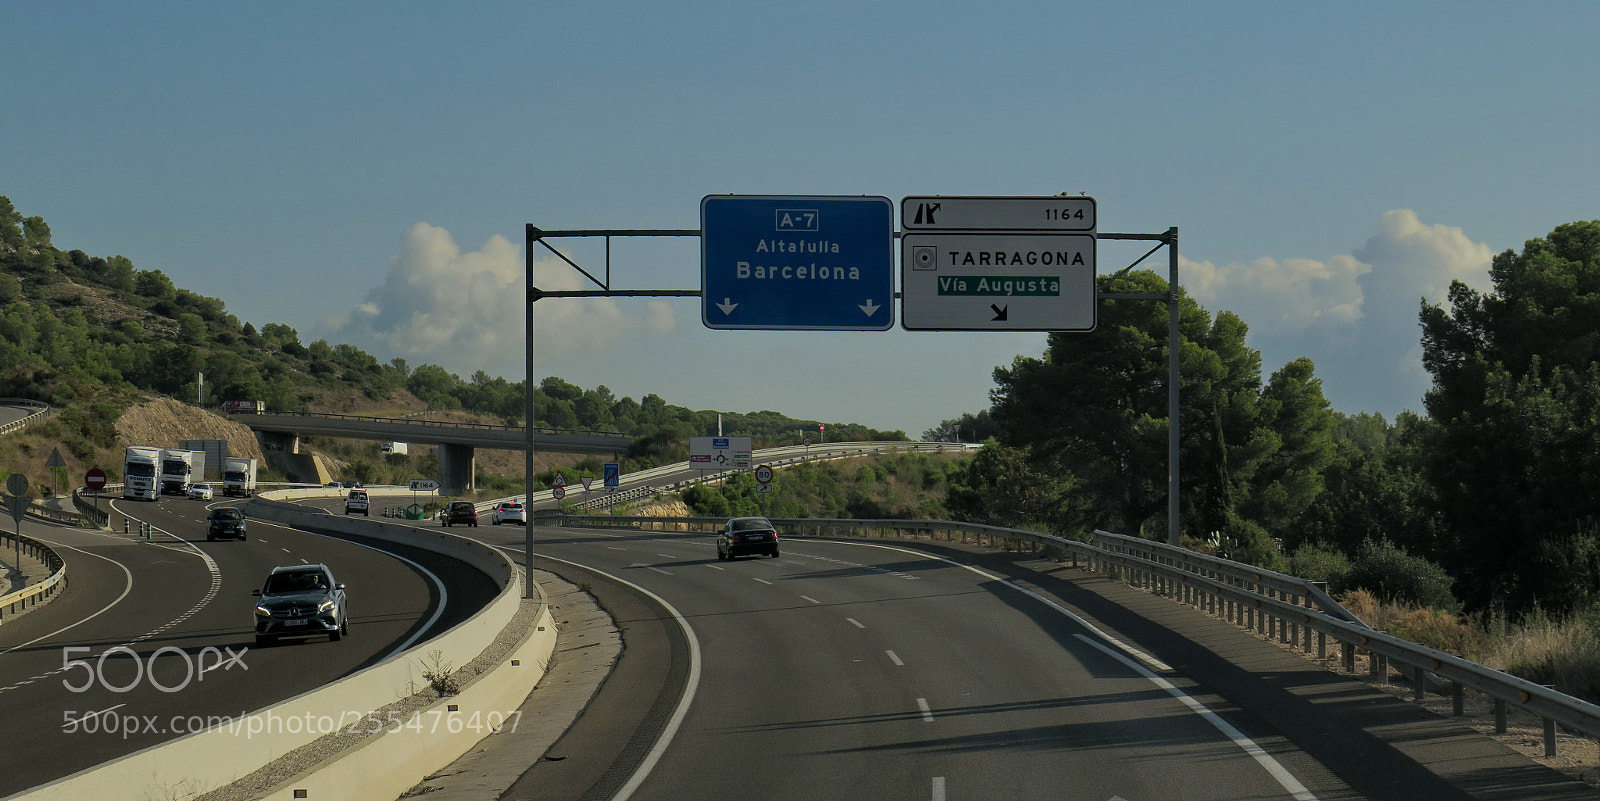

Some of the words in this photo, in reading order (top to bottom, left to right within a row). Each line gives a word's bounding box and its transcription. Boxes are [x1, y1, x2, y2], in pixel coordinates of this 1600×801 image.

[780, 213, 815, 227] A-7
[1045, 208, 1084, 221] 1164
[756, 239, 840, 253] Altafulla
[949, 251, 1084, 266] TARRAGONA
[736, 262, 860, 280] Barcelona
[939, 277, 967, 292] Vía
[977, 277, 1060, 296] Augusta
